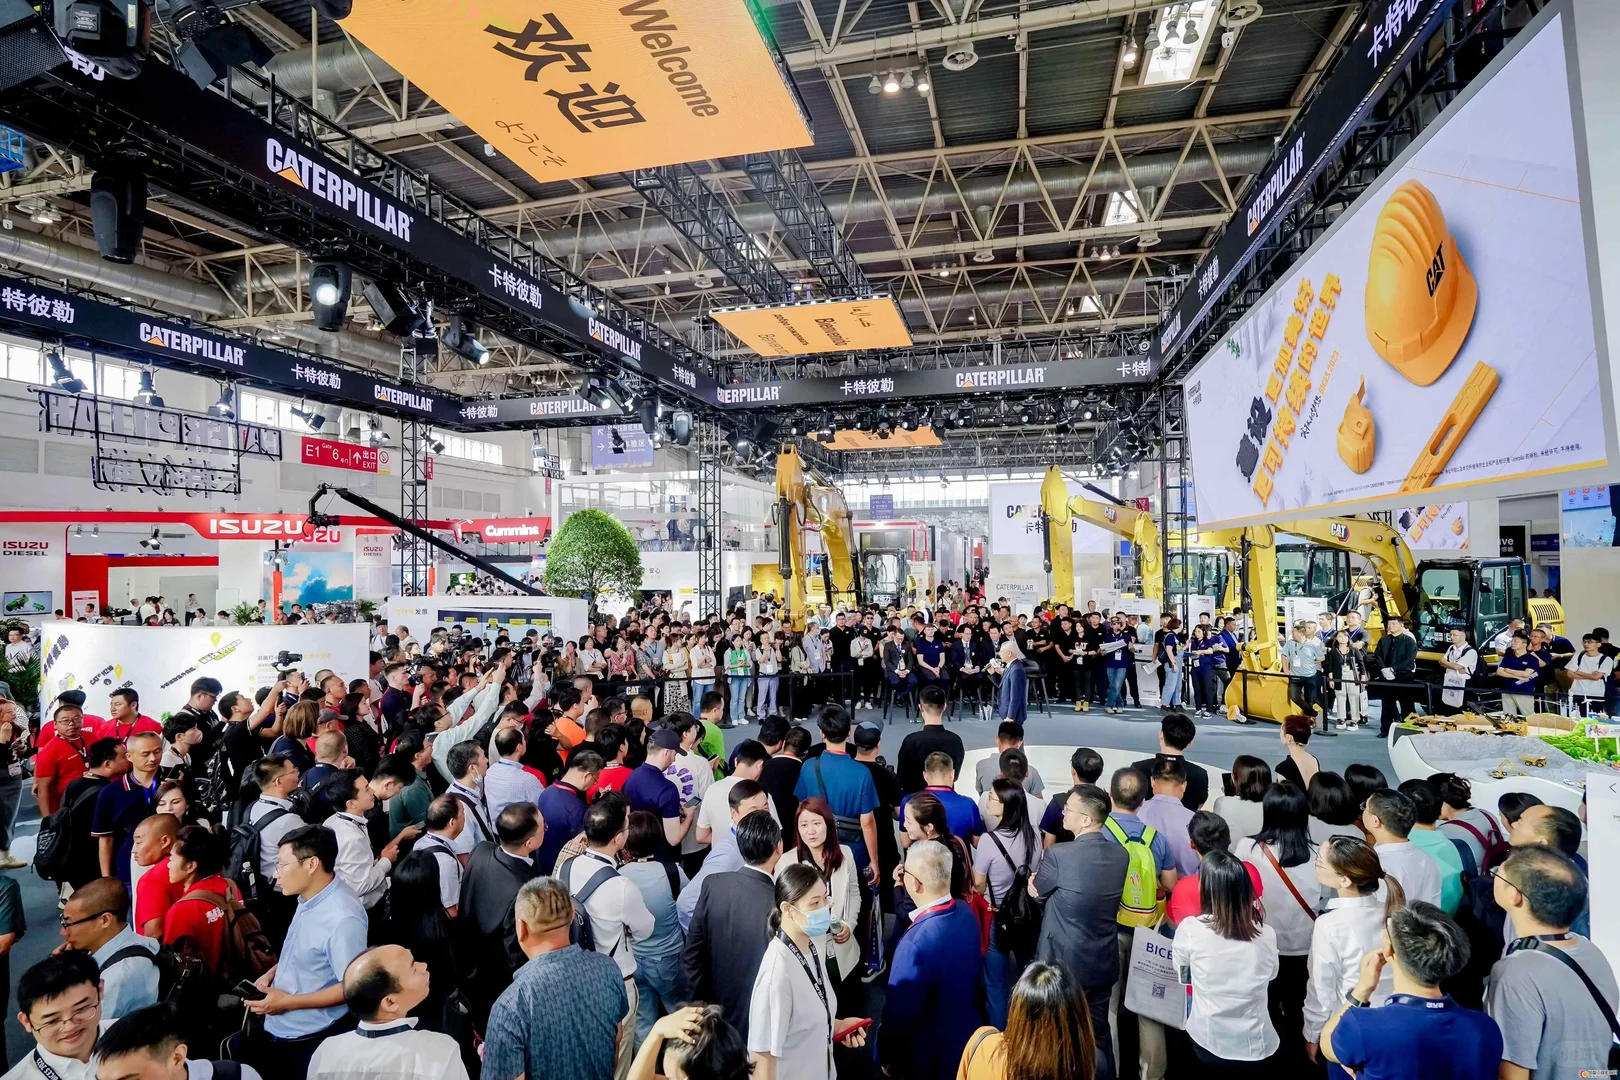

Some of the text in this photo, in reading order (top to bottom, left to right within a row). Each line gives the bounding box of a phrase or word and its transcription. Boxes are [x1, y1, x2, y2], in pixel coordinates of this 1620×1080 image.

[619, 0, 719, 119] Welcome
[484, 13, 646, 134] 欢迎
[494, 118, 568, 167] ようこそ
[266, 137, 413, 242] CATERPILLAR
[1247, 131, 1305, 237] CATERPILLAR
[1198, 256, 1220, 301] 卡特彼勒
[1425, 240, 1447, 297] CAT
[488, 263, 542, 310] 卡特彼勒
[1, 286, 75, 324] 特彼勒
[139, 321, 247, 365] CATERPILLAR
[588, 317, 642, 361] CATERPILLAR
[1328, 350, 1340, 373] 2023
[290, 363, 341, 390] 卡特彼勒
[671, 362, 697, 389] 卡特彼勒
[840, 377, 894, 395] 卡特彼勒
[955, 366, 1047, 389] CATERPILLAR
[373, 384, 434, 412] CATERPILLAR
[306, 444, 320, 458] E1
[332, 448, 339, 460] 6
[362, 450, 376, 460] 出口
[362, 460, 377, 470] EXIT
[1104, 506, 1116, 520] CAT
[209, 519, 303, 535] ISUZU
[485, 524, 539, 537] Cummins
[1330, 522, 1347, 538] CAT
[3, 541, 49, 549] ISUZU
[626, 685, 642, 696] CAT
[1146, 942, 1173, 961] BICE
